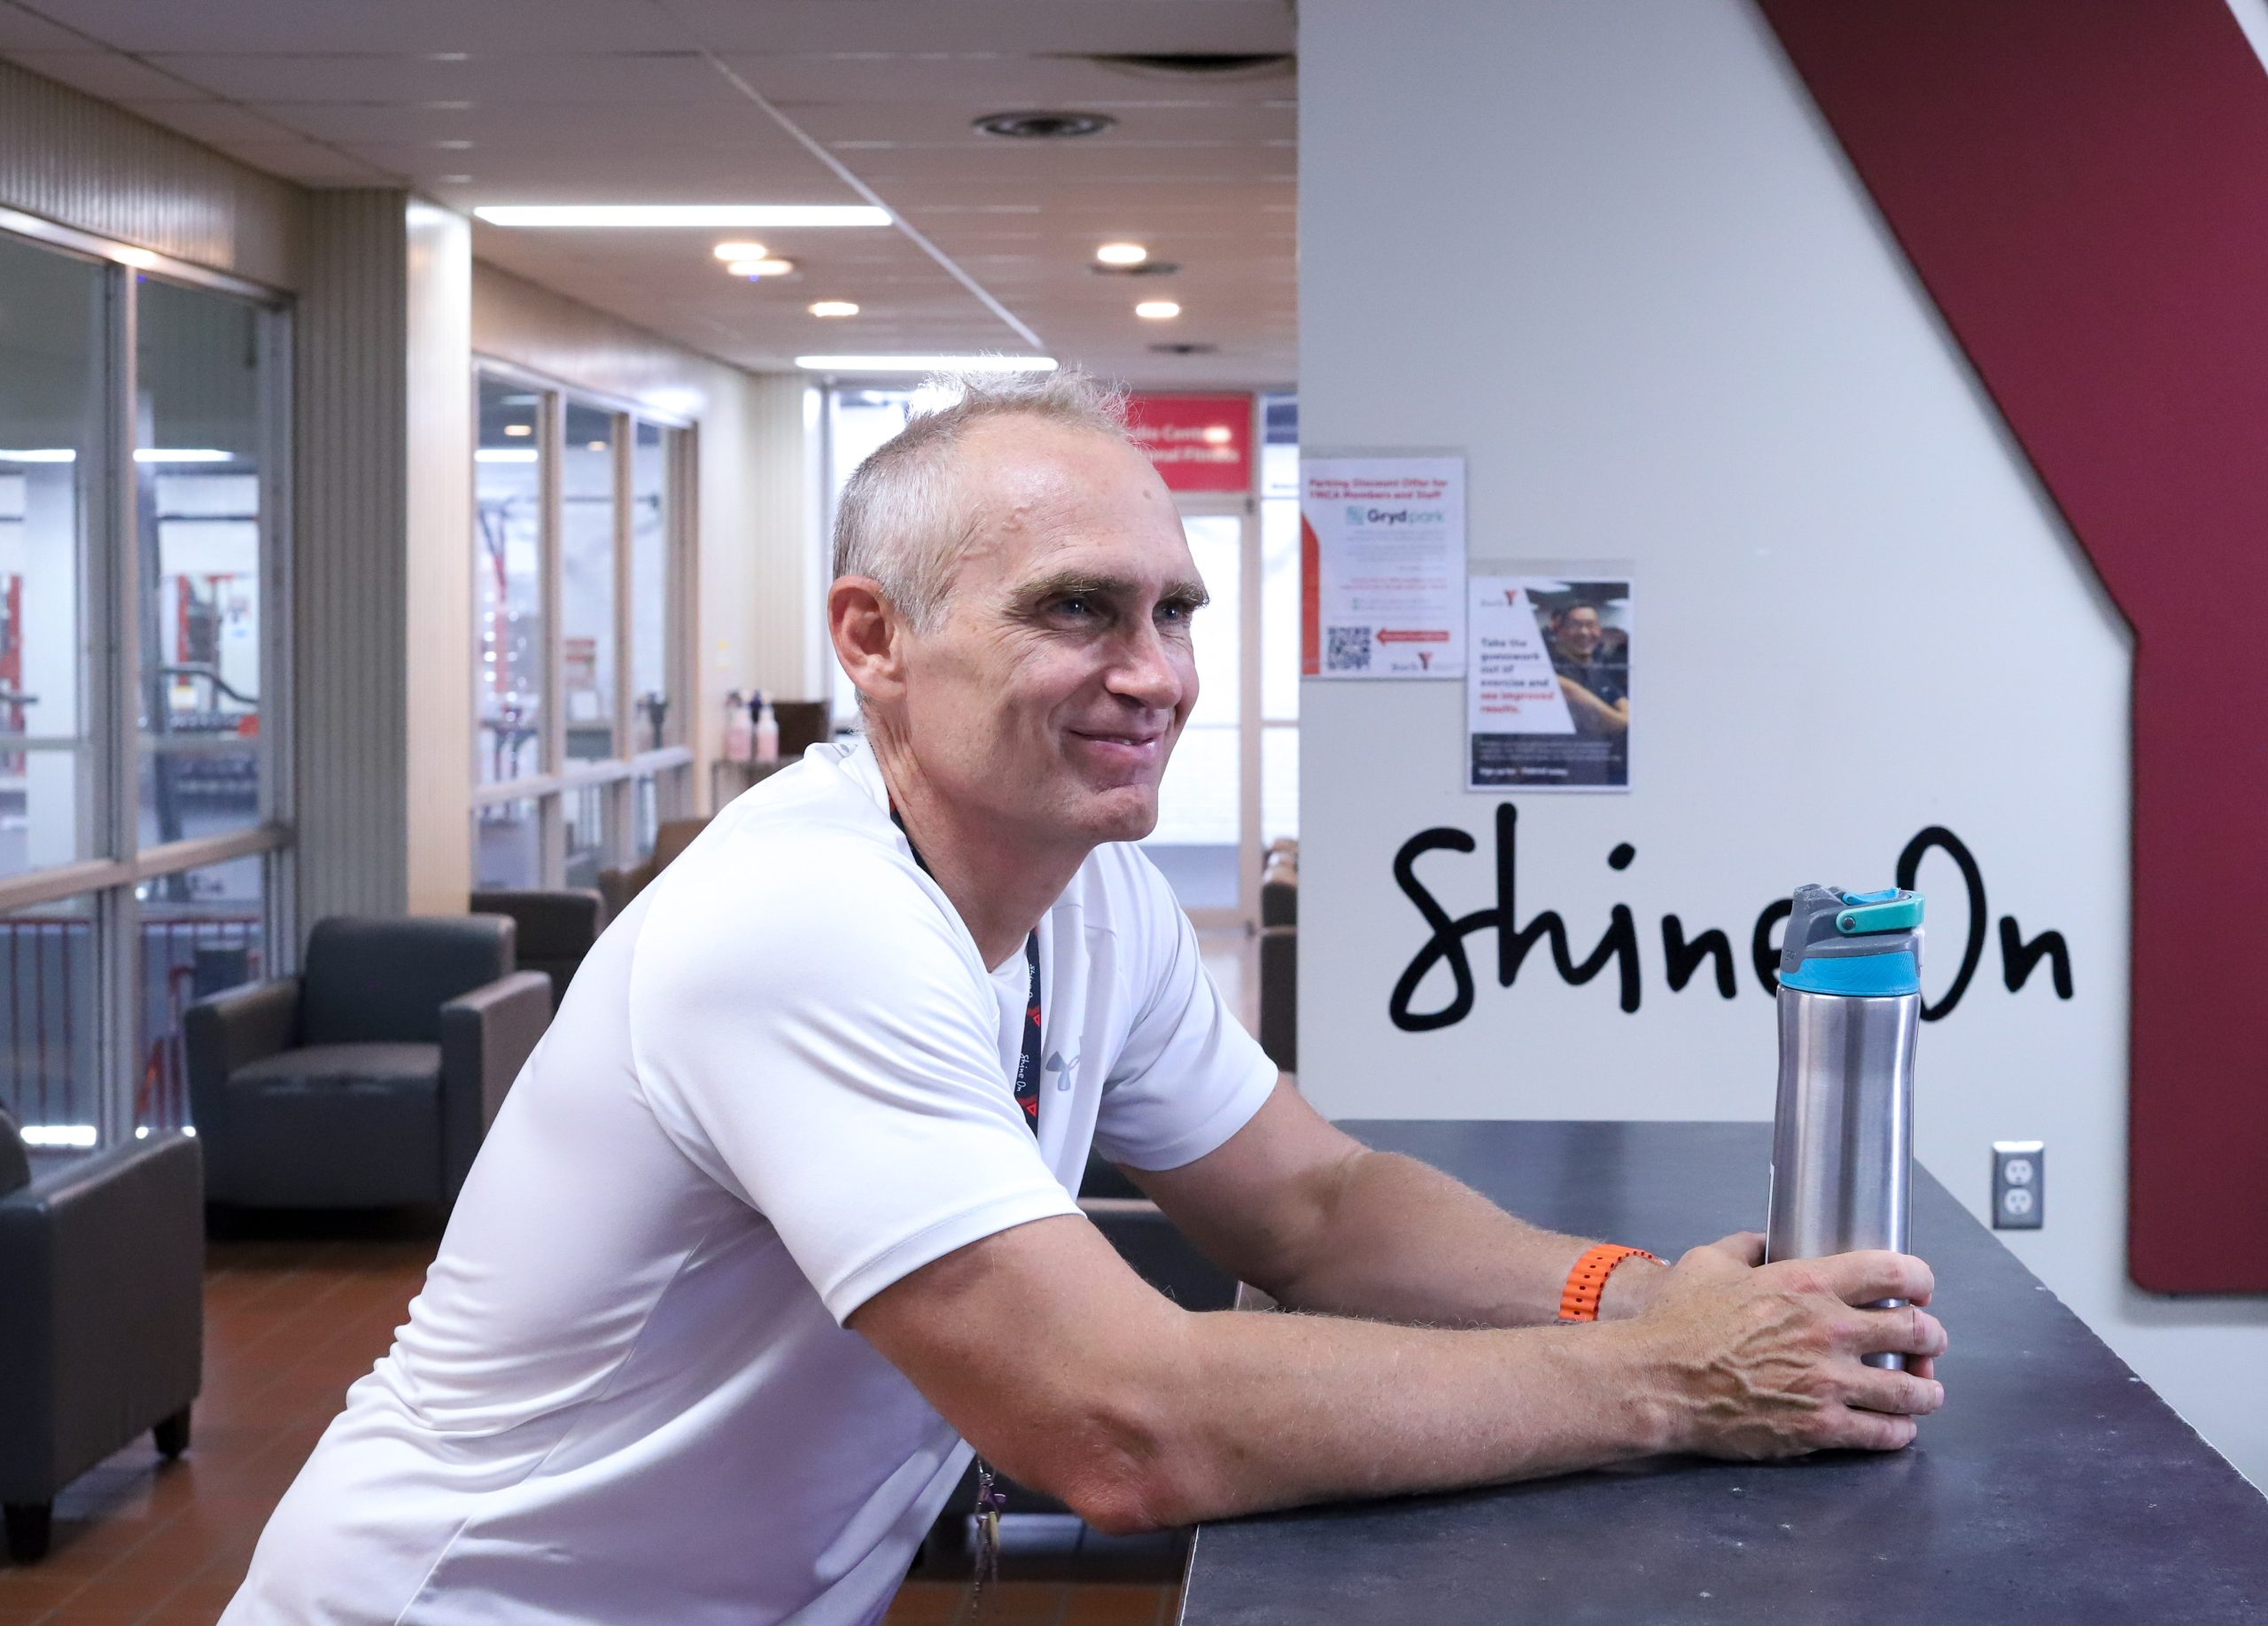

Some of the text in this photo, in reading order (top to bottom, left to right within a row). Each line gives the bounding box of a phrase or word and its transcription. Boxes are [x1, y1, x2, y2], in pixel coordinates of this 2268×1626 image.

[1309, 478, 1348, 488] Parking
[1481, 639, 1526, 648] Take the
[1896, 826, 2075, 1022] On
[1016, 1053, 1030, 1092] Shine On
